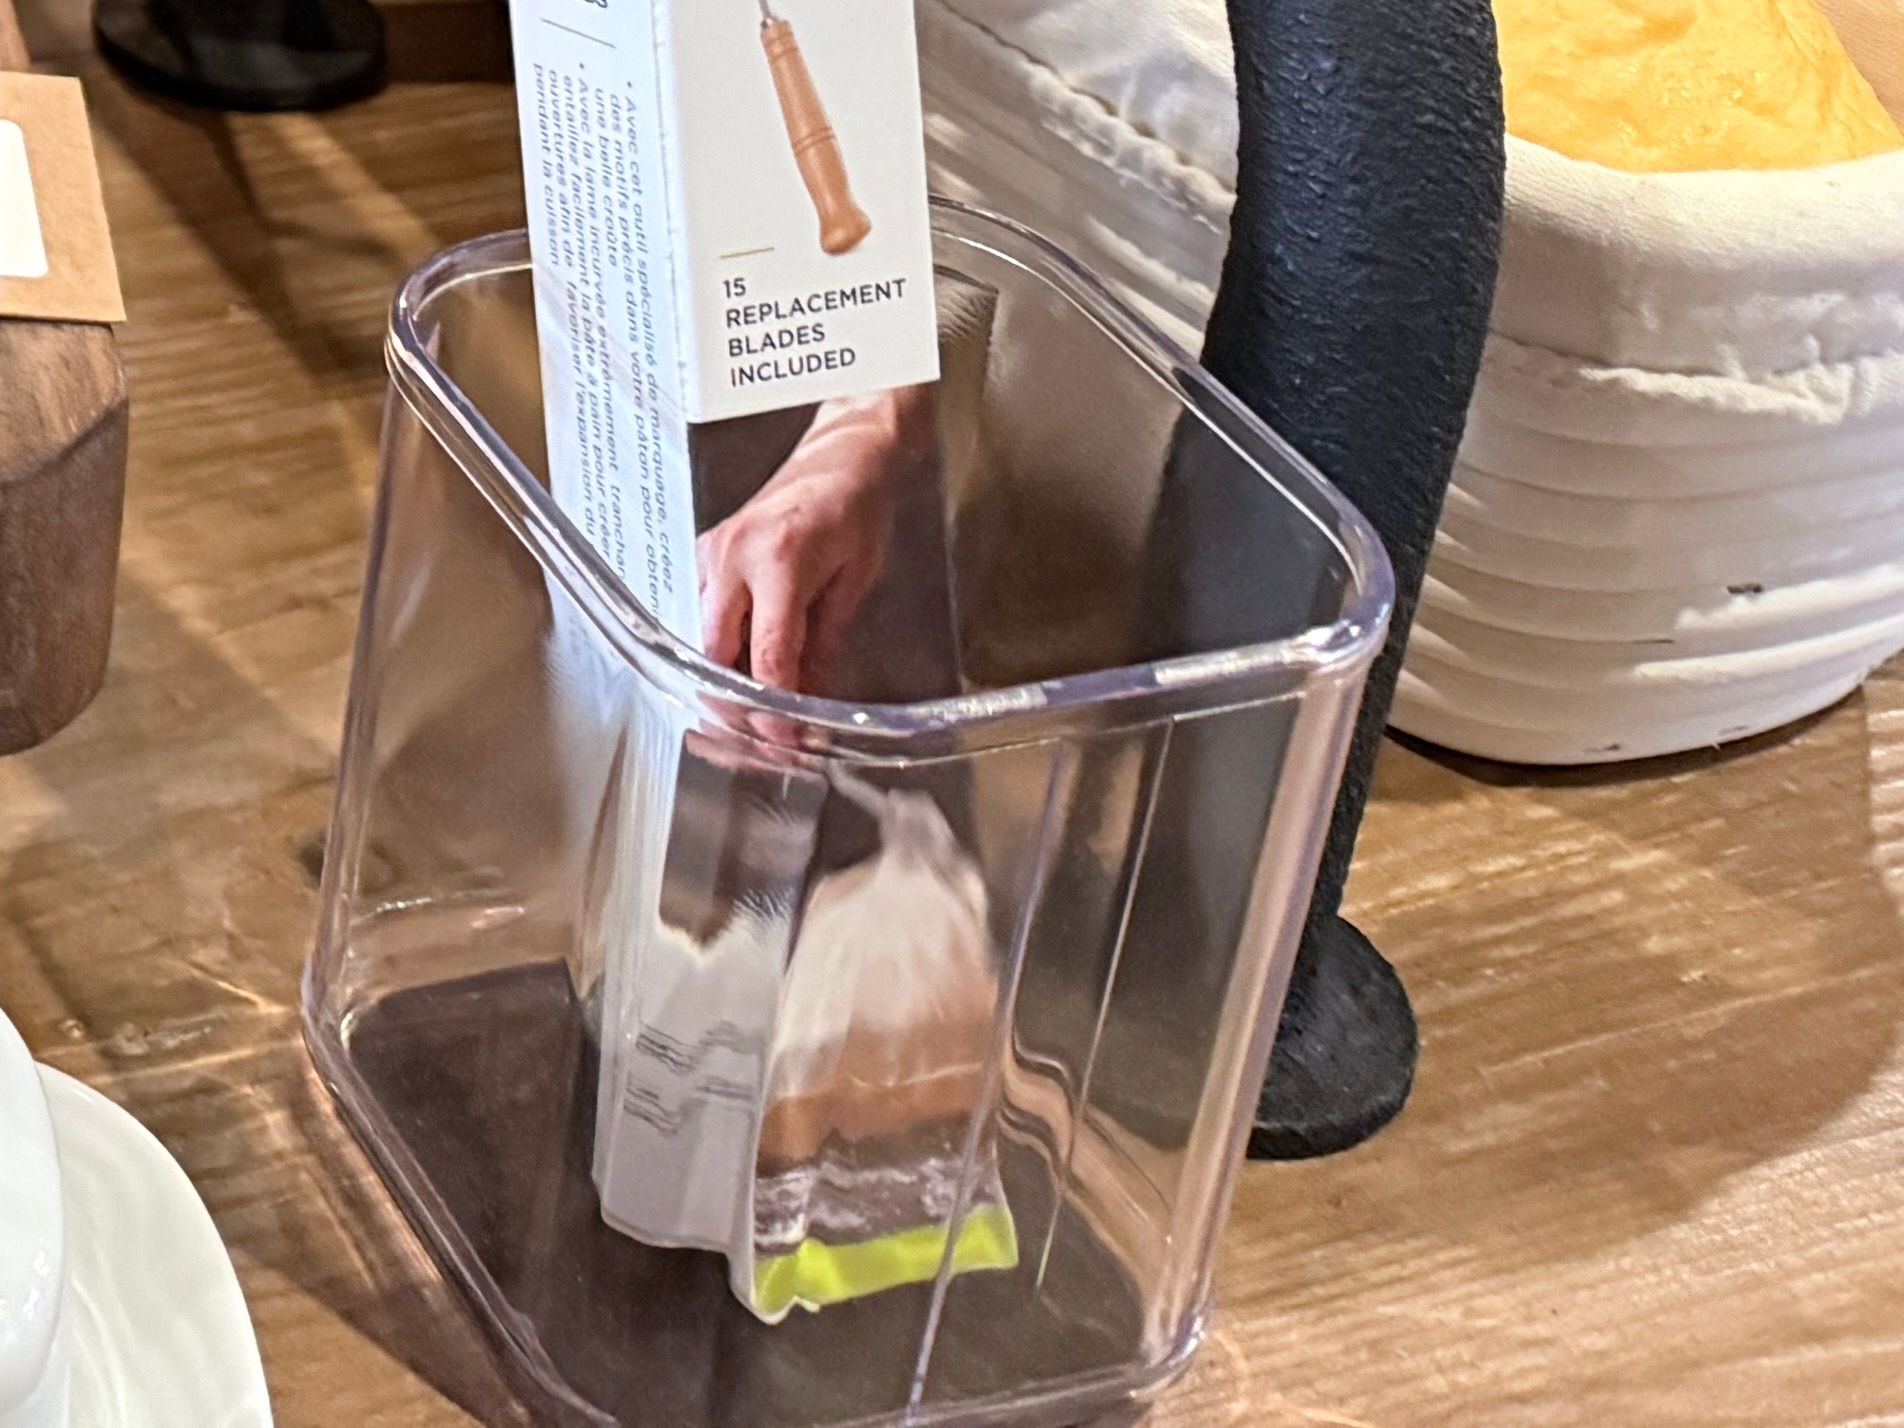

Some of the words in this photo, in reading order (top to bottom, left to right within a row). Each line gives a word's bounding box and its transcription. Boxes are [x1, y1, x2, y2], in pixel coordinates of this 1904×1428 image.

[563, 75, 579, 166] entaillez
[578, 78, 591, 134] Avec
[595, 87, 606, 129] une
[610, 93, 622, 132] des
[625, 96, 638, 154] Avec
[533, 63, 551, 153] pendant
[544, 184, 559, 266] cuisson
[598, 135, 613, 188] belle
[614, 140, 630, 209] motifs
[630, 161, 643, 195] cet
[585, 166, 597, 219] lame
[571, 173, 590, 286] facilement
[603, 195, 618, 267] croûte
[618, 216, 634, 283] précis
[633, 203, 649, 254] outil
[549, 69, 566, 186] ouvertures
[559, 192, 571, 233] afin
[566, 281, 583, 375] favoriser
[575, 381, 592, 502] l'expansion
[589, 225, 606, 319] incurvée
[722, 277, 748, 299] 15
[626, 290, 638, 342] dans
[637, 259, 658, 366] spécialisé
[726, 277, 907, 329] REPLACEMENT
[582, 317, 596, 367] pâte
[728, 322, 826, 358] BLADES
[730, 347, 857, 388] INCLUDED
[597, 325, 619, 471] extrêmement
[630, 351, 644, 409] votre
[588, 391, 601, 439] pain
[592, 444, 606, 497] pour
[634, 414, 649, 480] pâton
[649, 407, 667, 524] marquage,
[598, 502, 611, 557] créer
[610, 484, 626, 580] tranchan
[639, 485, 654, 538] pour
[646, 544, 663, 620] obteni
[659, 532, 673, 594] créez
